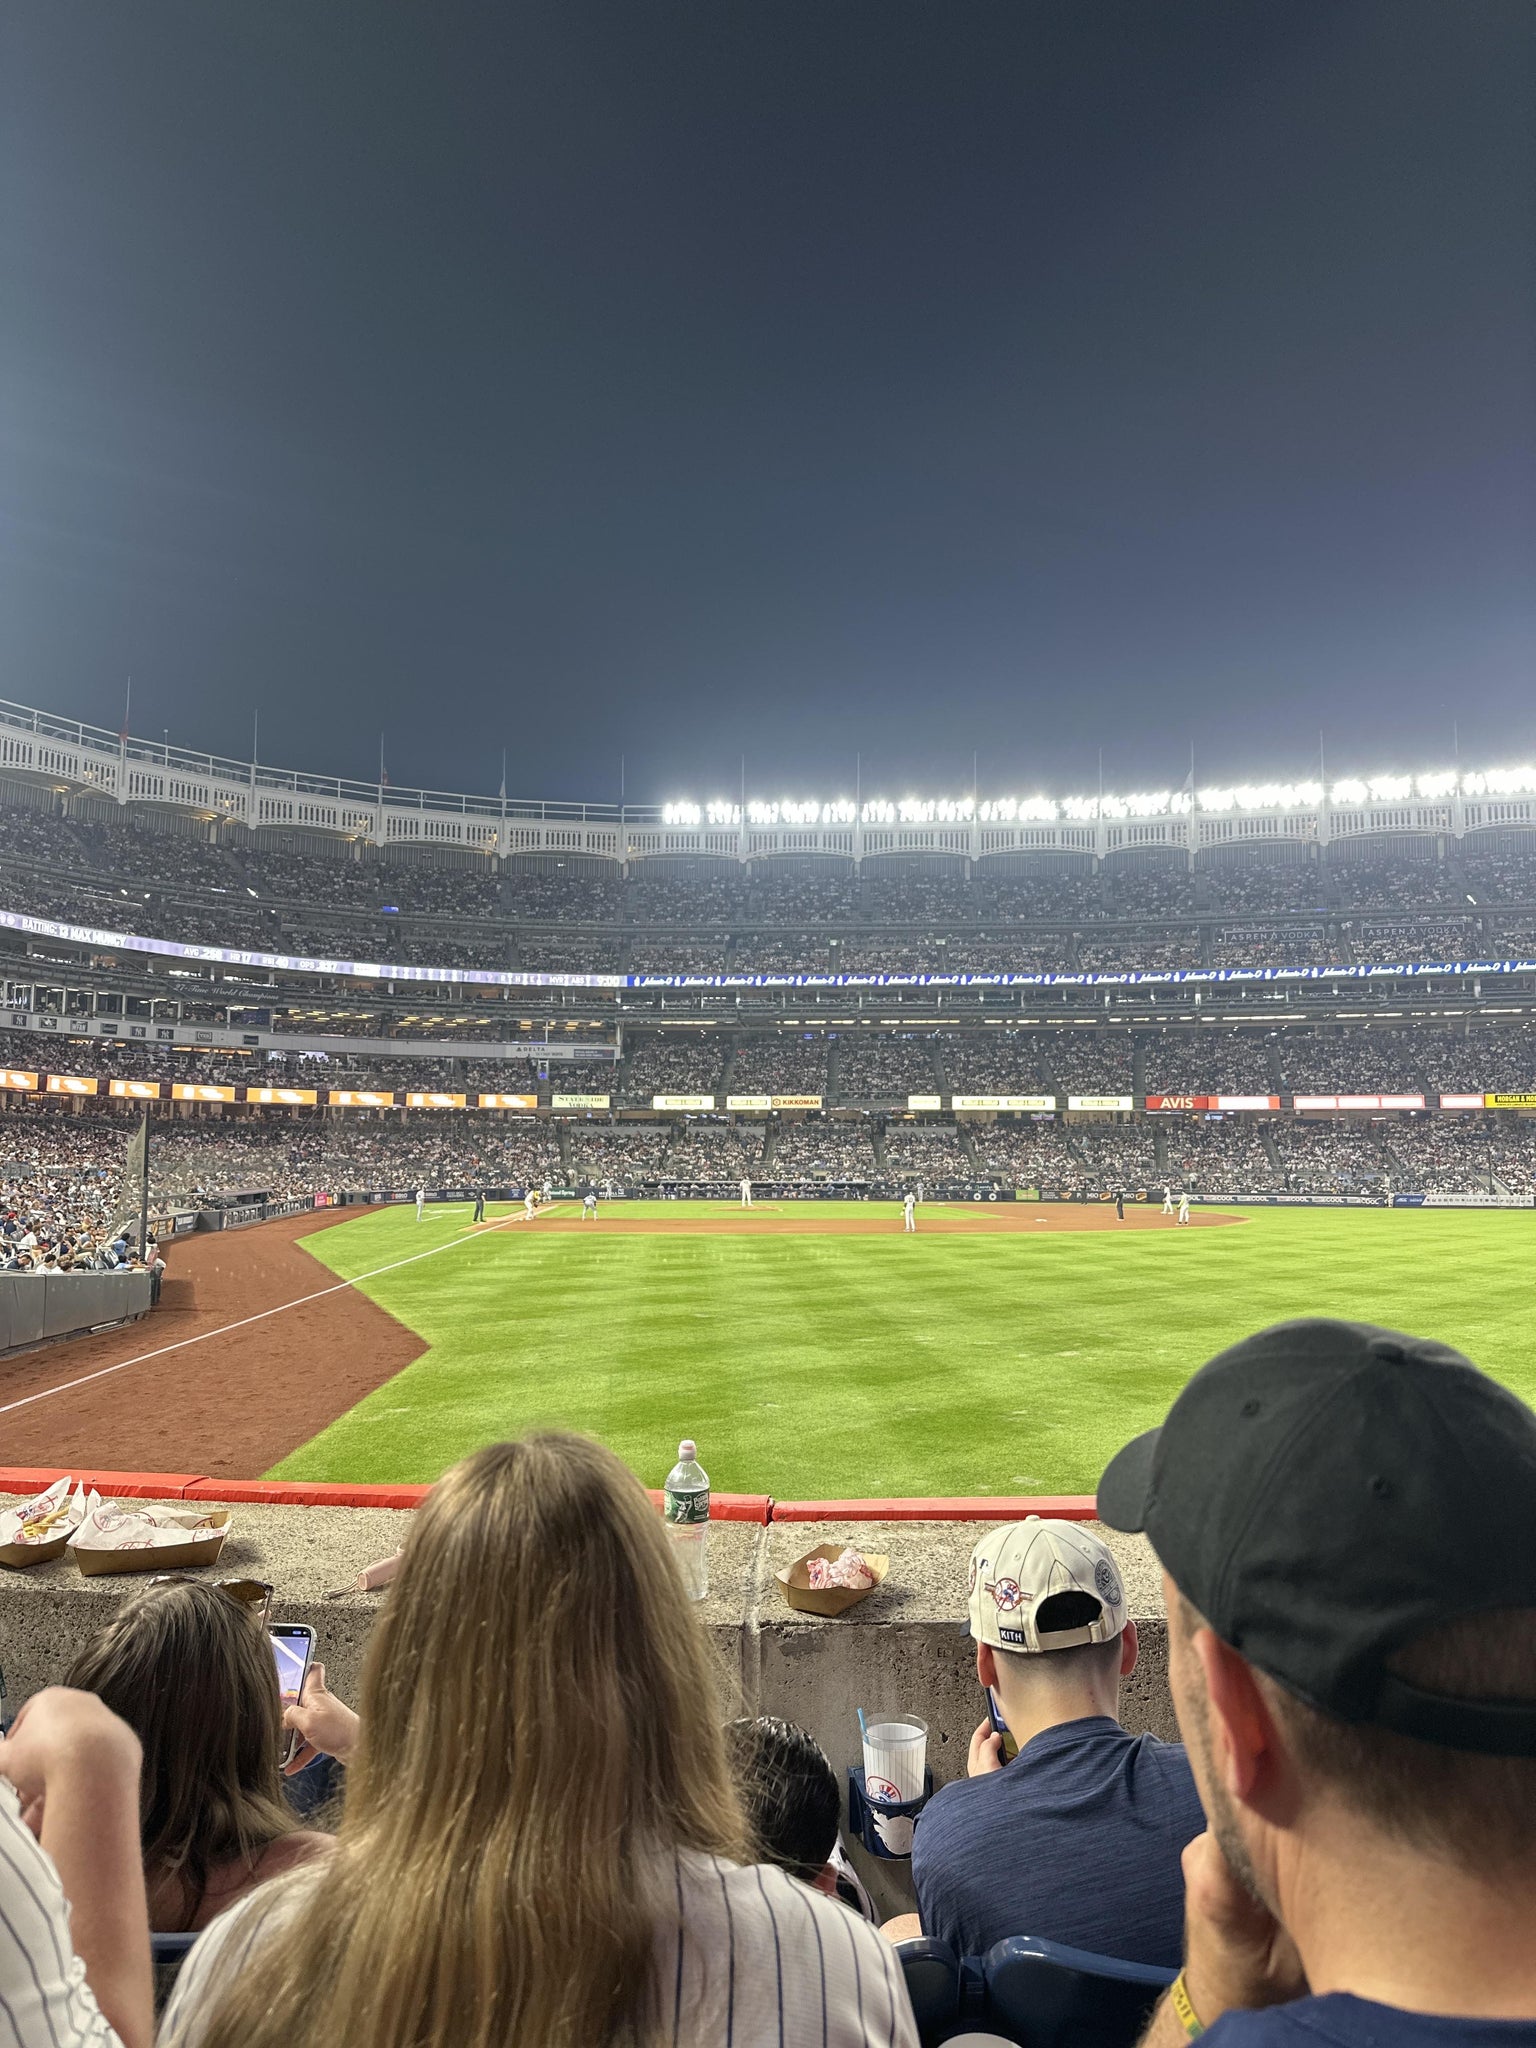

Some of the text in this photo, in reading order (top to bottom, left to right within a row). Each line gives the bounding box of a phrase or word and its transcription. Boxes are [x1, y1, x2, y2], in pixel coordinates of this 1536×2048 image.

[22, 918, 58, 935] BATTING:
[70, 927, 91, 942] MAX
[92, 931, 127, 947] MUNCY
[1231, 931, 1318, 941] ASPEN VODKA
[1368, 926, 1458, 936] ASPEN VODKA
[184, 947, 199, 957] AVG
[230, 952, 241, 962] HR
[300, 961, 315, 970] OPS
[571, 976, 584, 984] ABS
[212, 987, 237, 996] World
[238, 990, 279, 1000] Champions
[1160, 1098, 1194, 1108] AVIS
[1000, 1631, 1023, 1642] KITH
